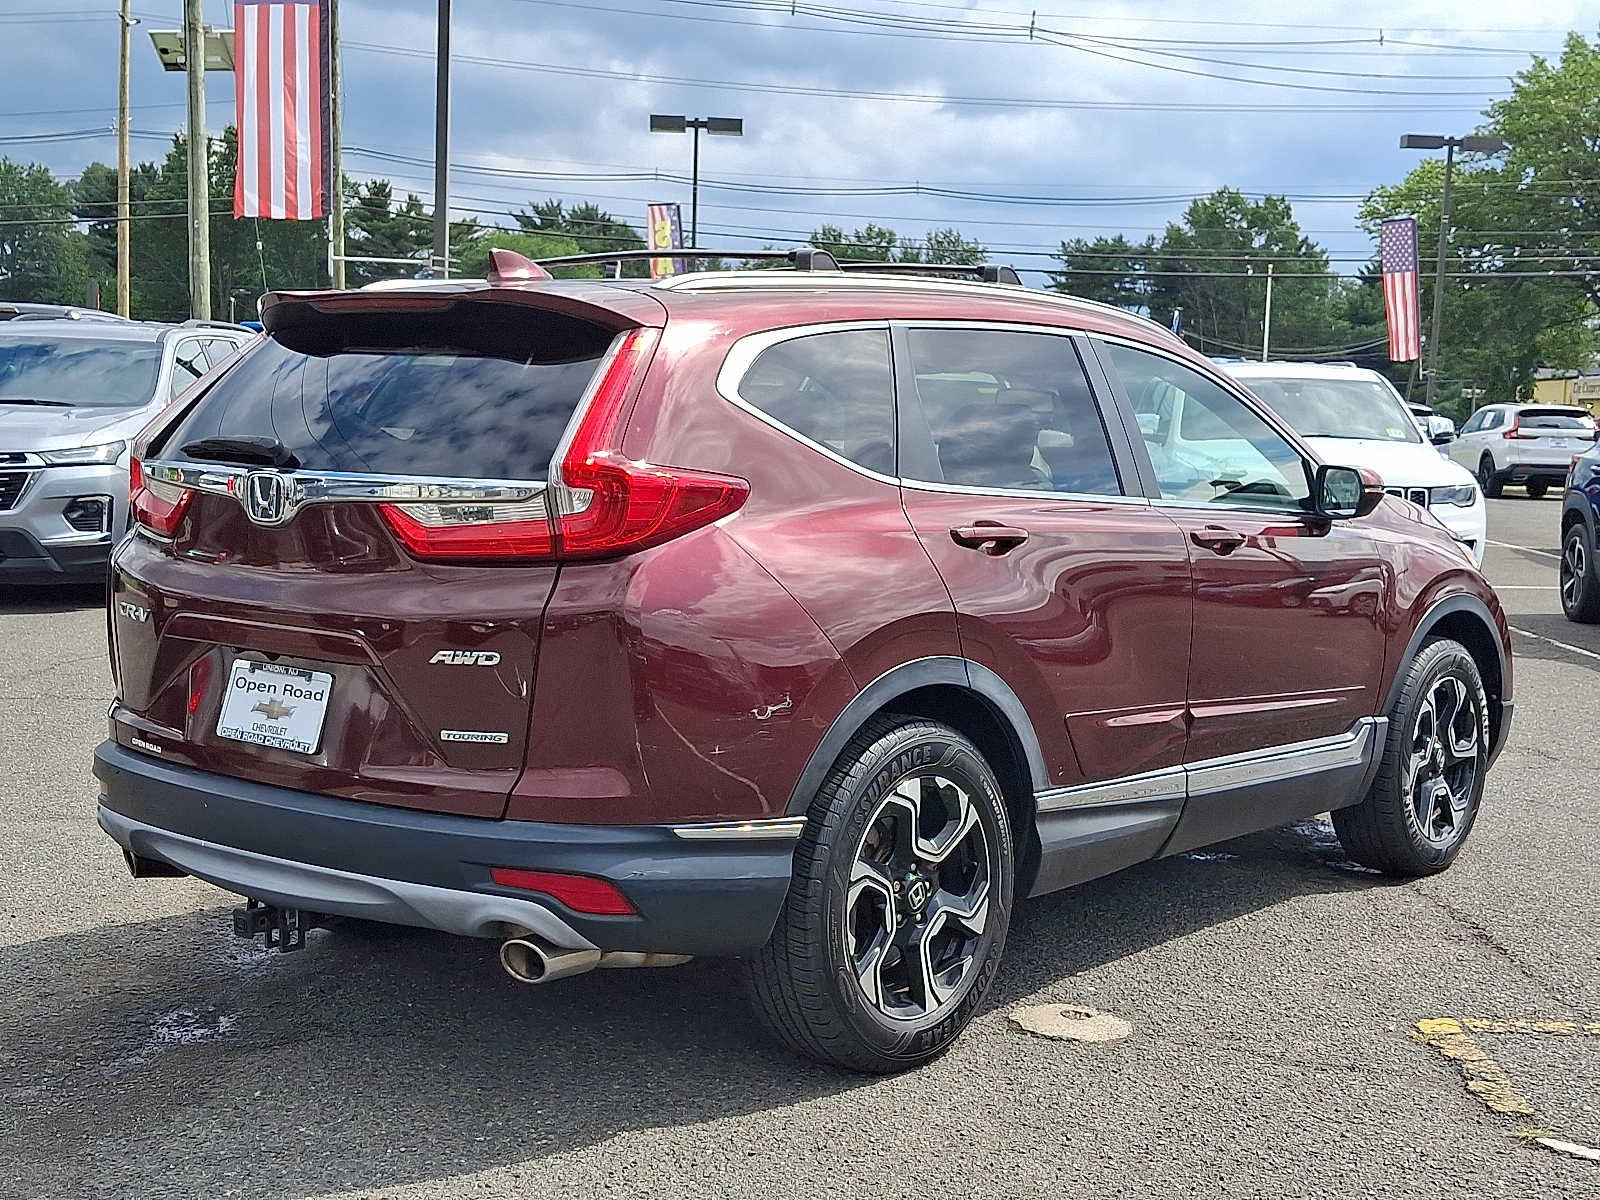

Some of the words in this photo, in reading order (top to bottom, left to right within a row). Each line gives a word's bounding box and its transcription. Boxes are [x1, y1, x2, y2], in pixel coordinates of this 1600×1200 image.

[120, 601, 151, 622] CR-V
[429, 650, 501, 666] AWD
[288, 667, 299, 676] NJ
[235, 676, 277, 694] Open
[283, 684, 324, 701] Road
[252, 723, 288, 736] CHEVROLET
[444, 732, 506, 742] TOURING
[221, 728, 242, 739] OPEN
[242, 732, 264, 743] ROAD
[265, 736, 310, 752] CHEVROLET
[848, 745, 933, 840] ASSURANCE
